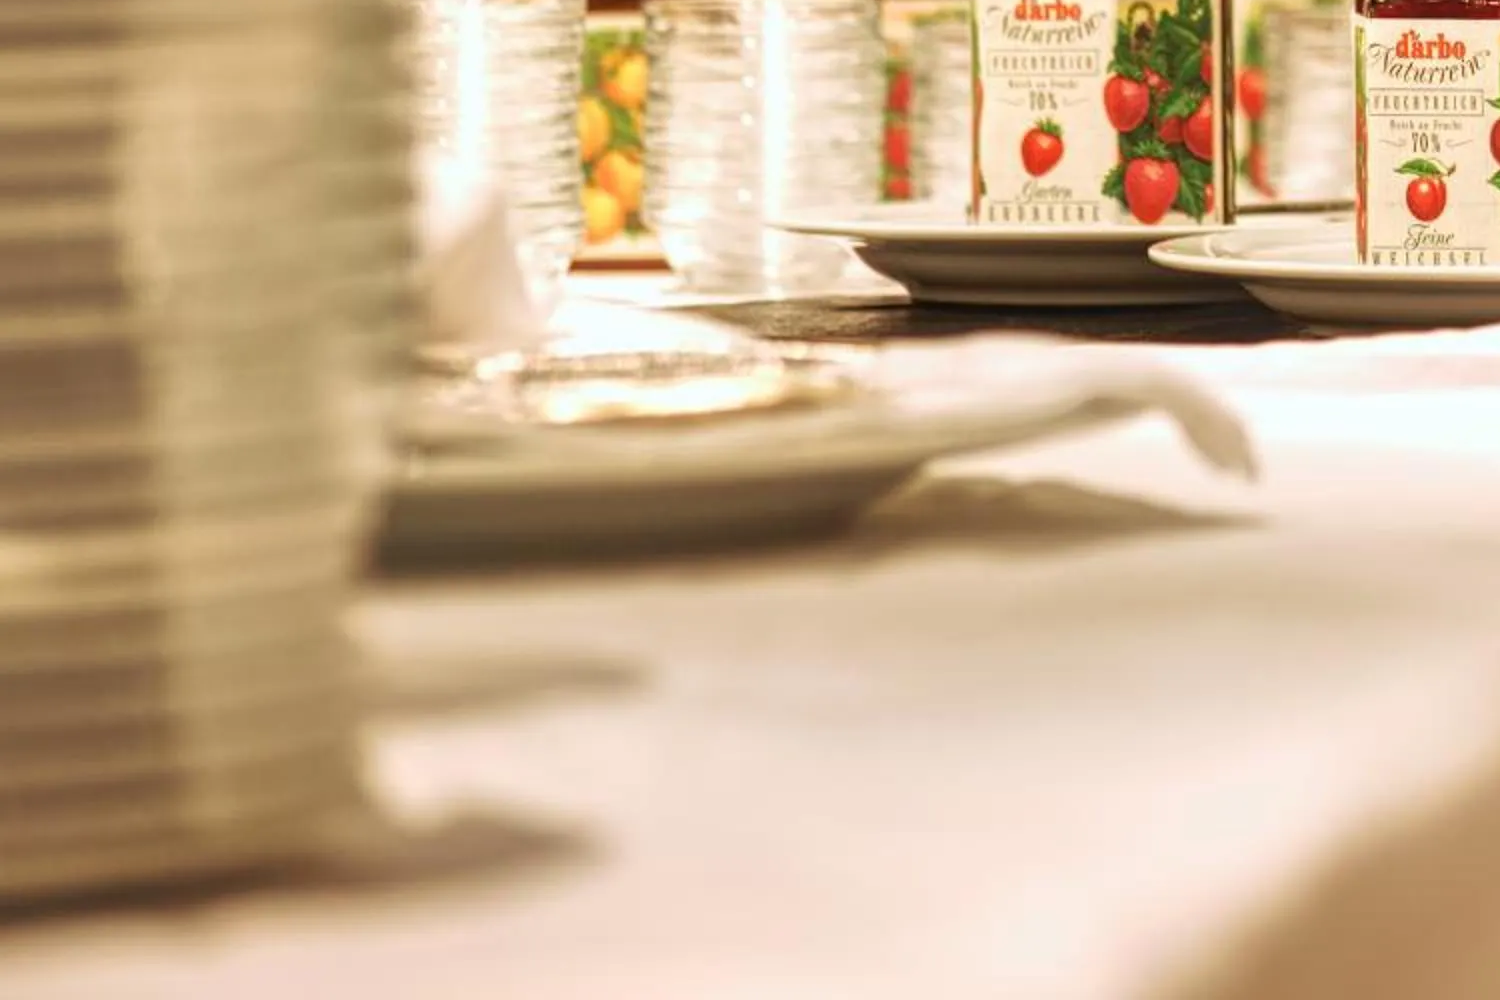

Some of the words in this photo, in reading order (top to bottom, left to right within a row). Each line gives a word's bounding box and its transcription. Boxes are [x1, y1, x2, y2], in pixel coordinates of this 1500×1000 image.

[985, 4, 1107, 45] Naturrein
[1368, 42, 1491, 84] Naturrein
[1374, 95, 1478, 111] FRUCHTREICH
[1411, 132, 1441, 153] 70%
[1403, 223, 1455, 250] Feine
[1372, 251, 1488, 267] WEICHSEL
